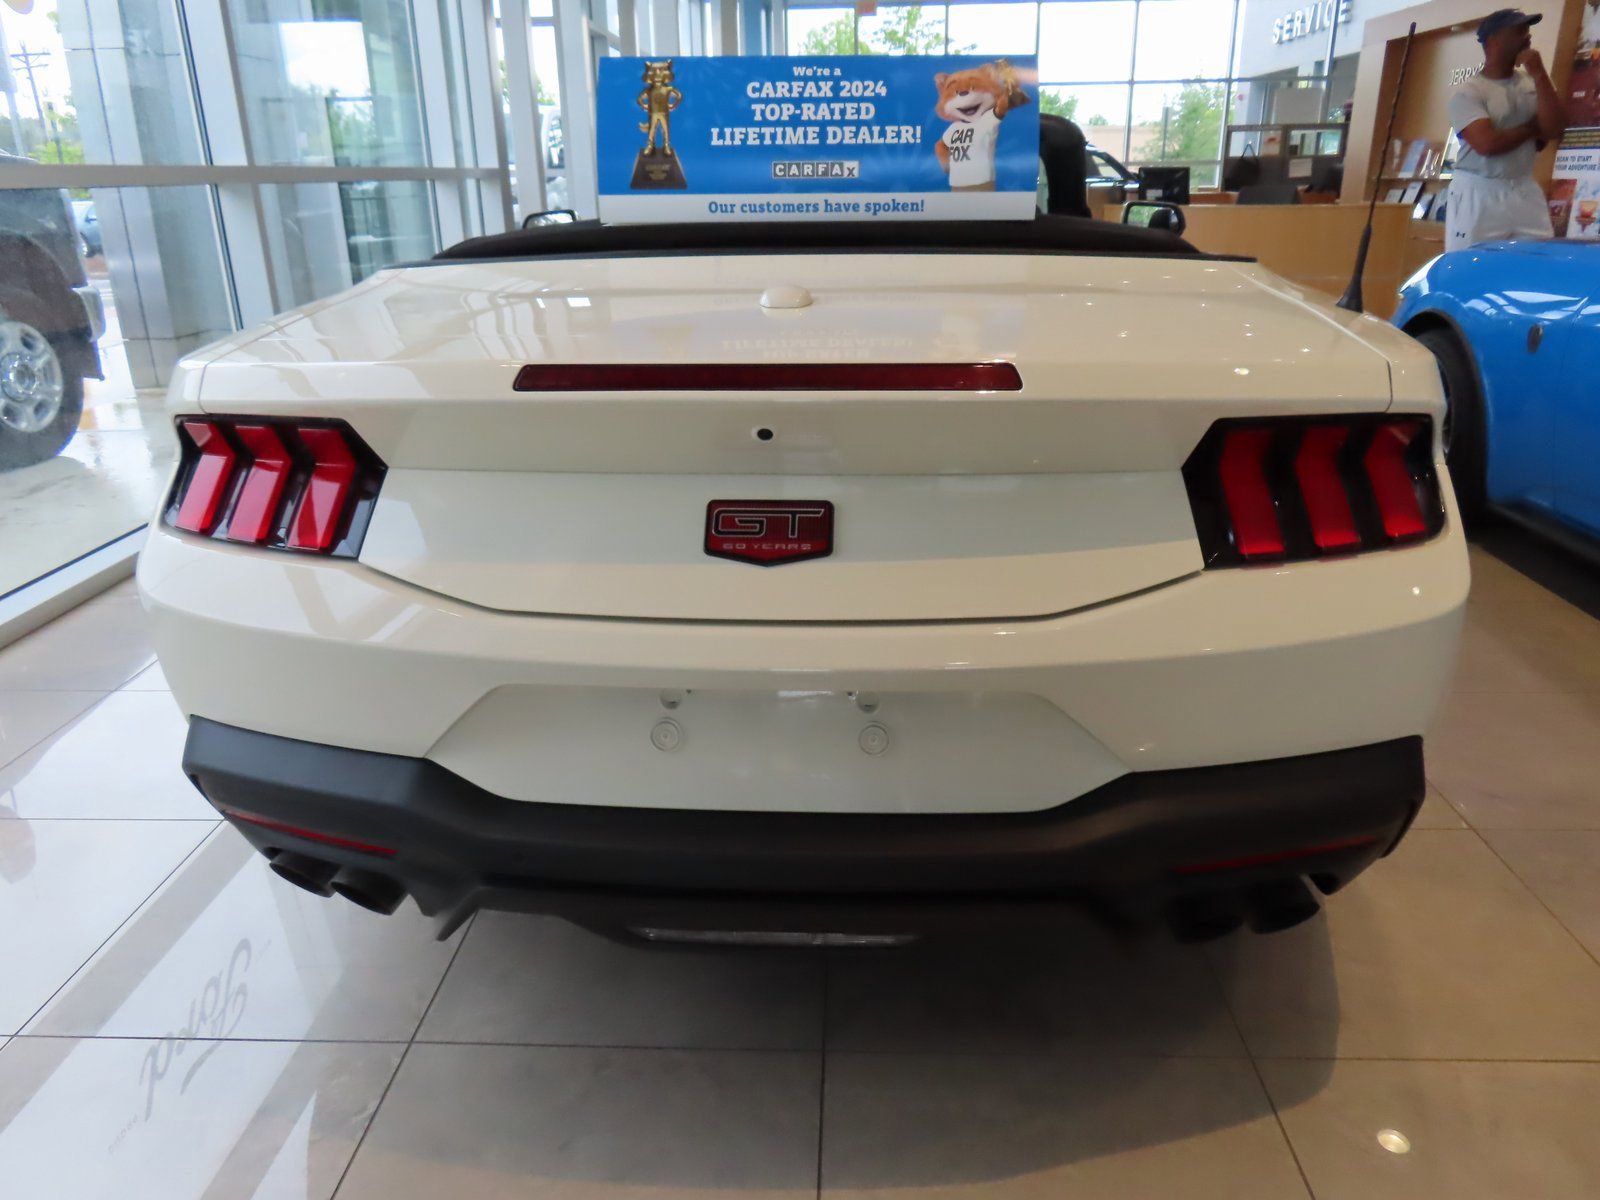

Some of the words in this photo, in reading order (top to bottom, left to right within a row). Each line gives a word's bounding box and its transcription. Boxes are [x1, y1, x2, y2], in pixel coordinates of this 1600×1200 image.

[1272, 0, 1352, 44] SERVICE
[793, 66, 830, 77] We're
[833, 68, 842, 77] a
[746, 81, 834, 98] CARFAX
[839, 80, 888, 97] 2024
[751, 102, 876, 121] TOP-RATED
[710, 126, 820, 146] LIFETIME
[826, 125, 922, 144] DEALER!
[708, 201, 736, 214] Our
[740, 200, 820, 214] customers
[823, 199, 860, 214] have
[864, 199, 925, 216] spoken!
[712, 507, 825, 539] GT
[139, 937, 252, 1122] Ford
